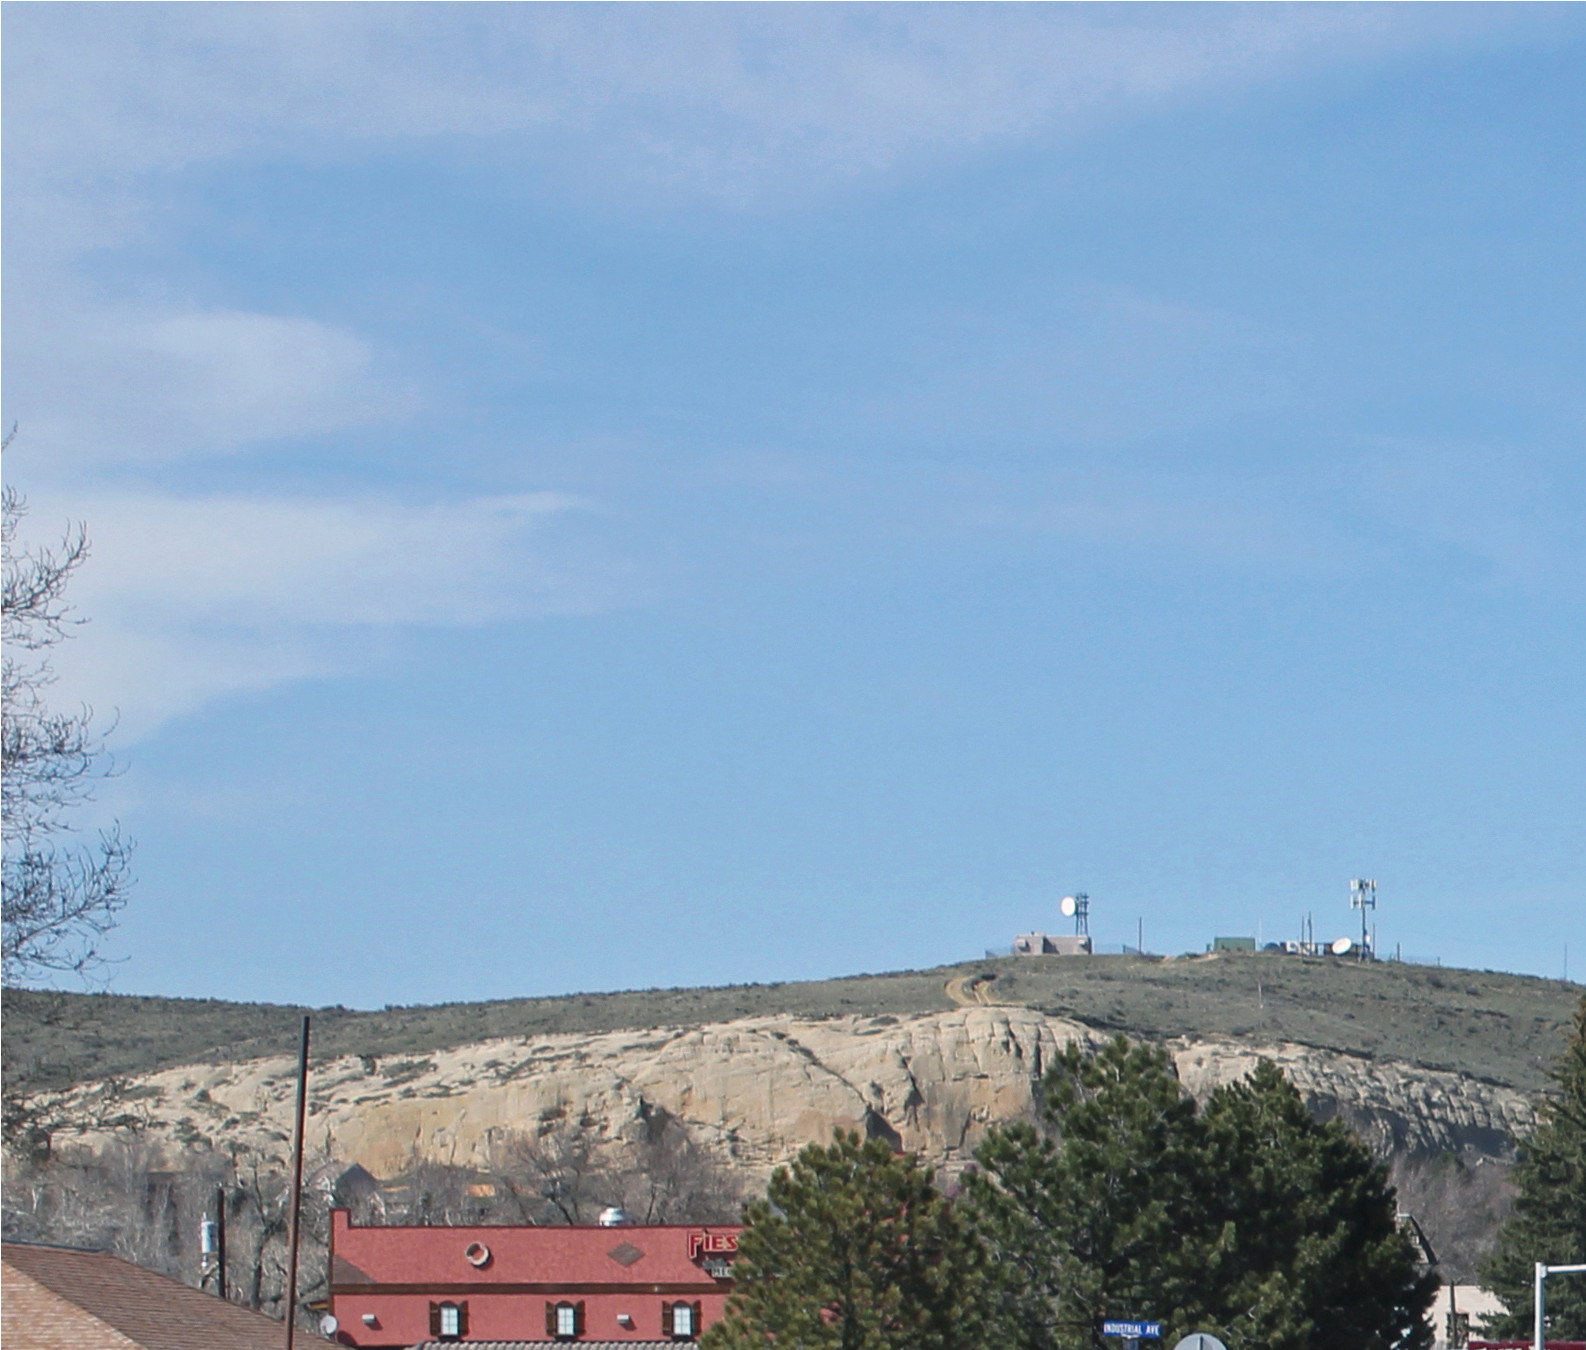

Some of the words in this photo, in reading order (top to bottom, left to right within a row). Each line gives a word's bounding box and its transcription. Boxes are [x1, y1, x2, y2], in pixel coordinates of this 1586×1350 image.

[688, 1233, 739, 1259] FIES
[1103, 1323, 1141, 1334] INDUSTRIAL
[1146, 1324, 1159, 1336] AVE
